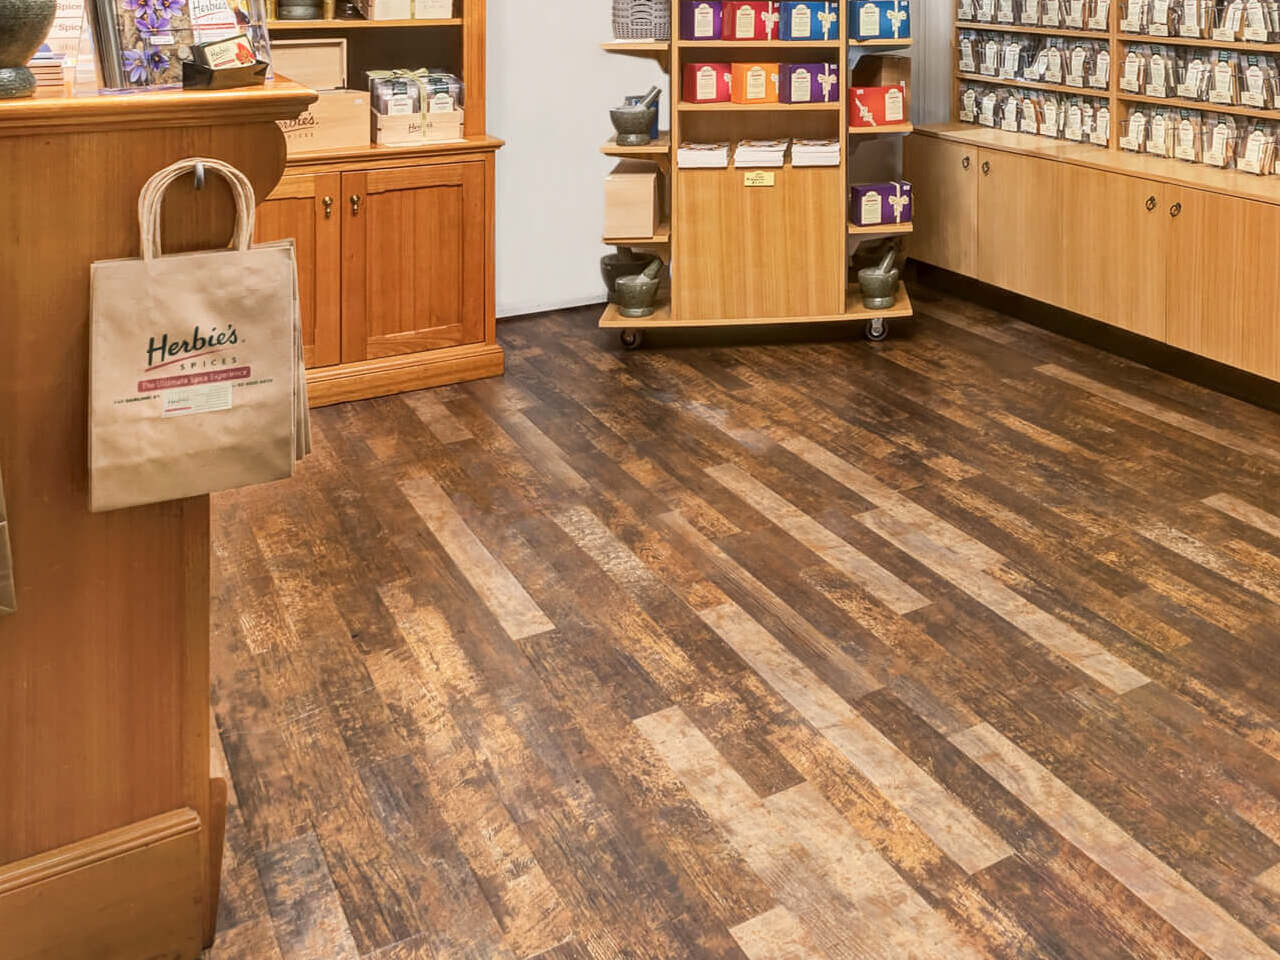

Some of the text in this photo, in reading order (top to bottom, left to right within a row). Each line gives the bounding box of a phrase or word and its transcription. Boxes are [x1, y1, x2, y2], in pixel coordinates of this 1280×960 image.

[146, 324, 239, 366] Herbie's
[179, 356, 238, 371] SPICES
[142, 380, 156, 390] The
